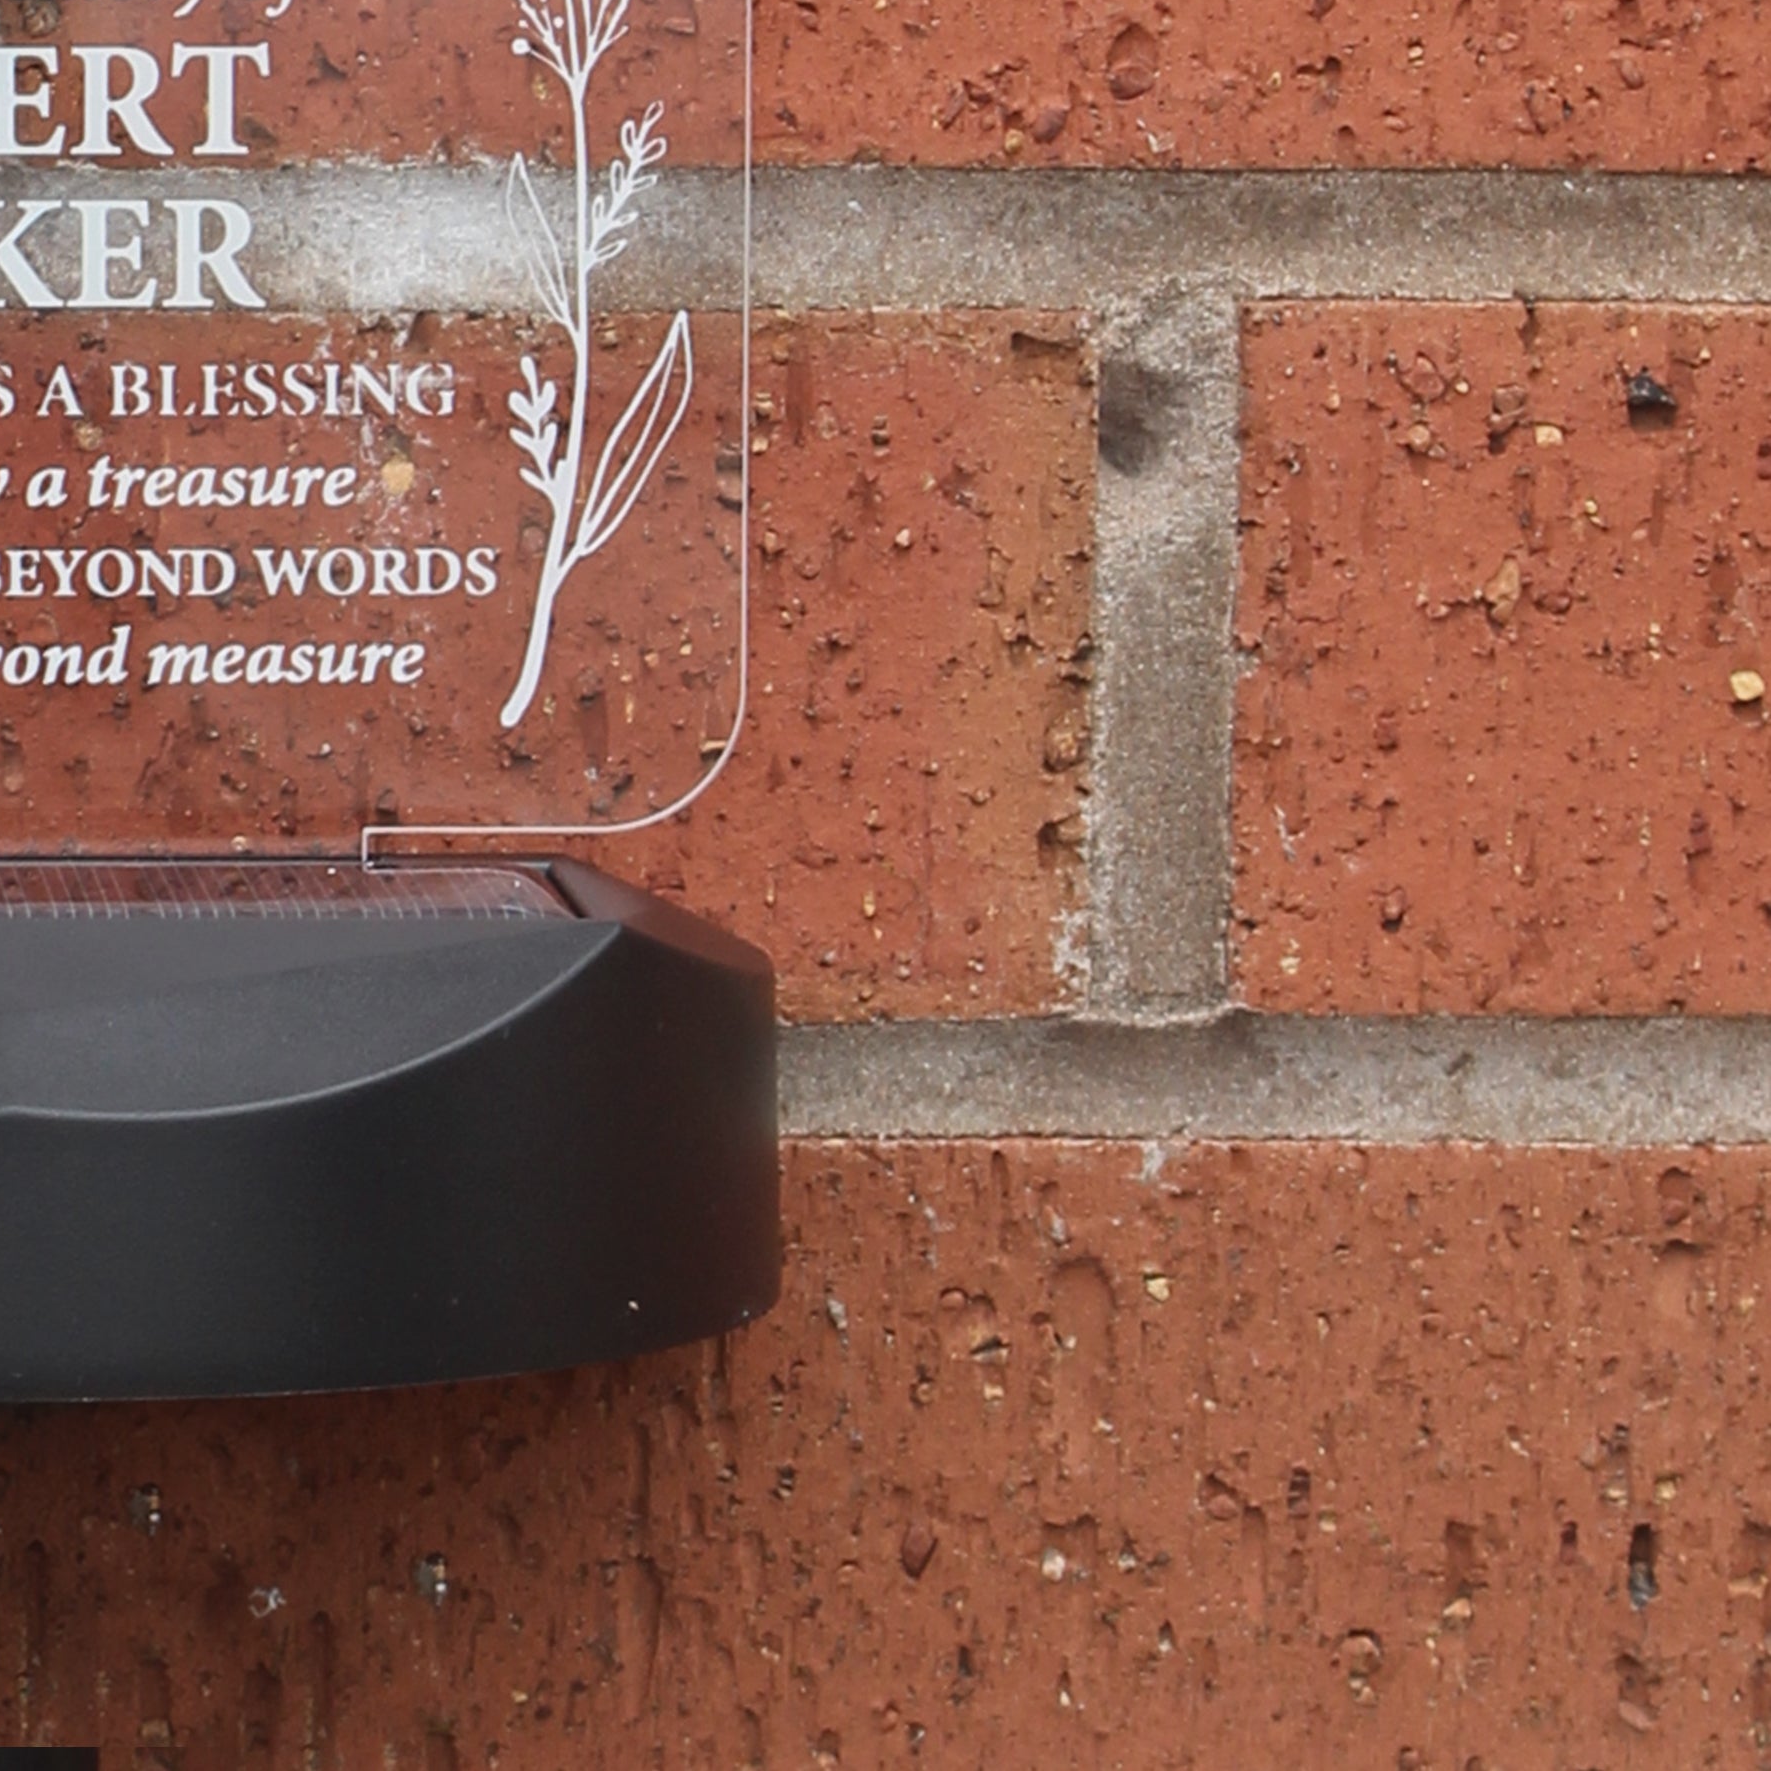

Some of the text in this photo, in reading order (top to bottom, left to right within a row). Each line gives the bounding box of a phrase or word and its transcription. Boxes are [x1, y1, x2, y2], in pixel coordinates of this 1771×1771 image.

[37, 364, 83, 416] A
[110, 362, 456, 417] BLESSING
[26, 464, 68, 508] a
[87, 454, 358, 508] treasure
[252, 547, 499, 597] WORDS
[146, 641, 425, 685] measure
